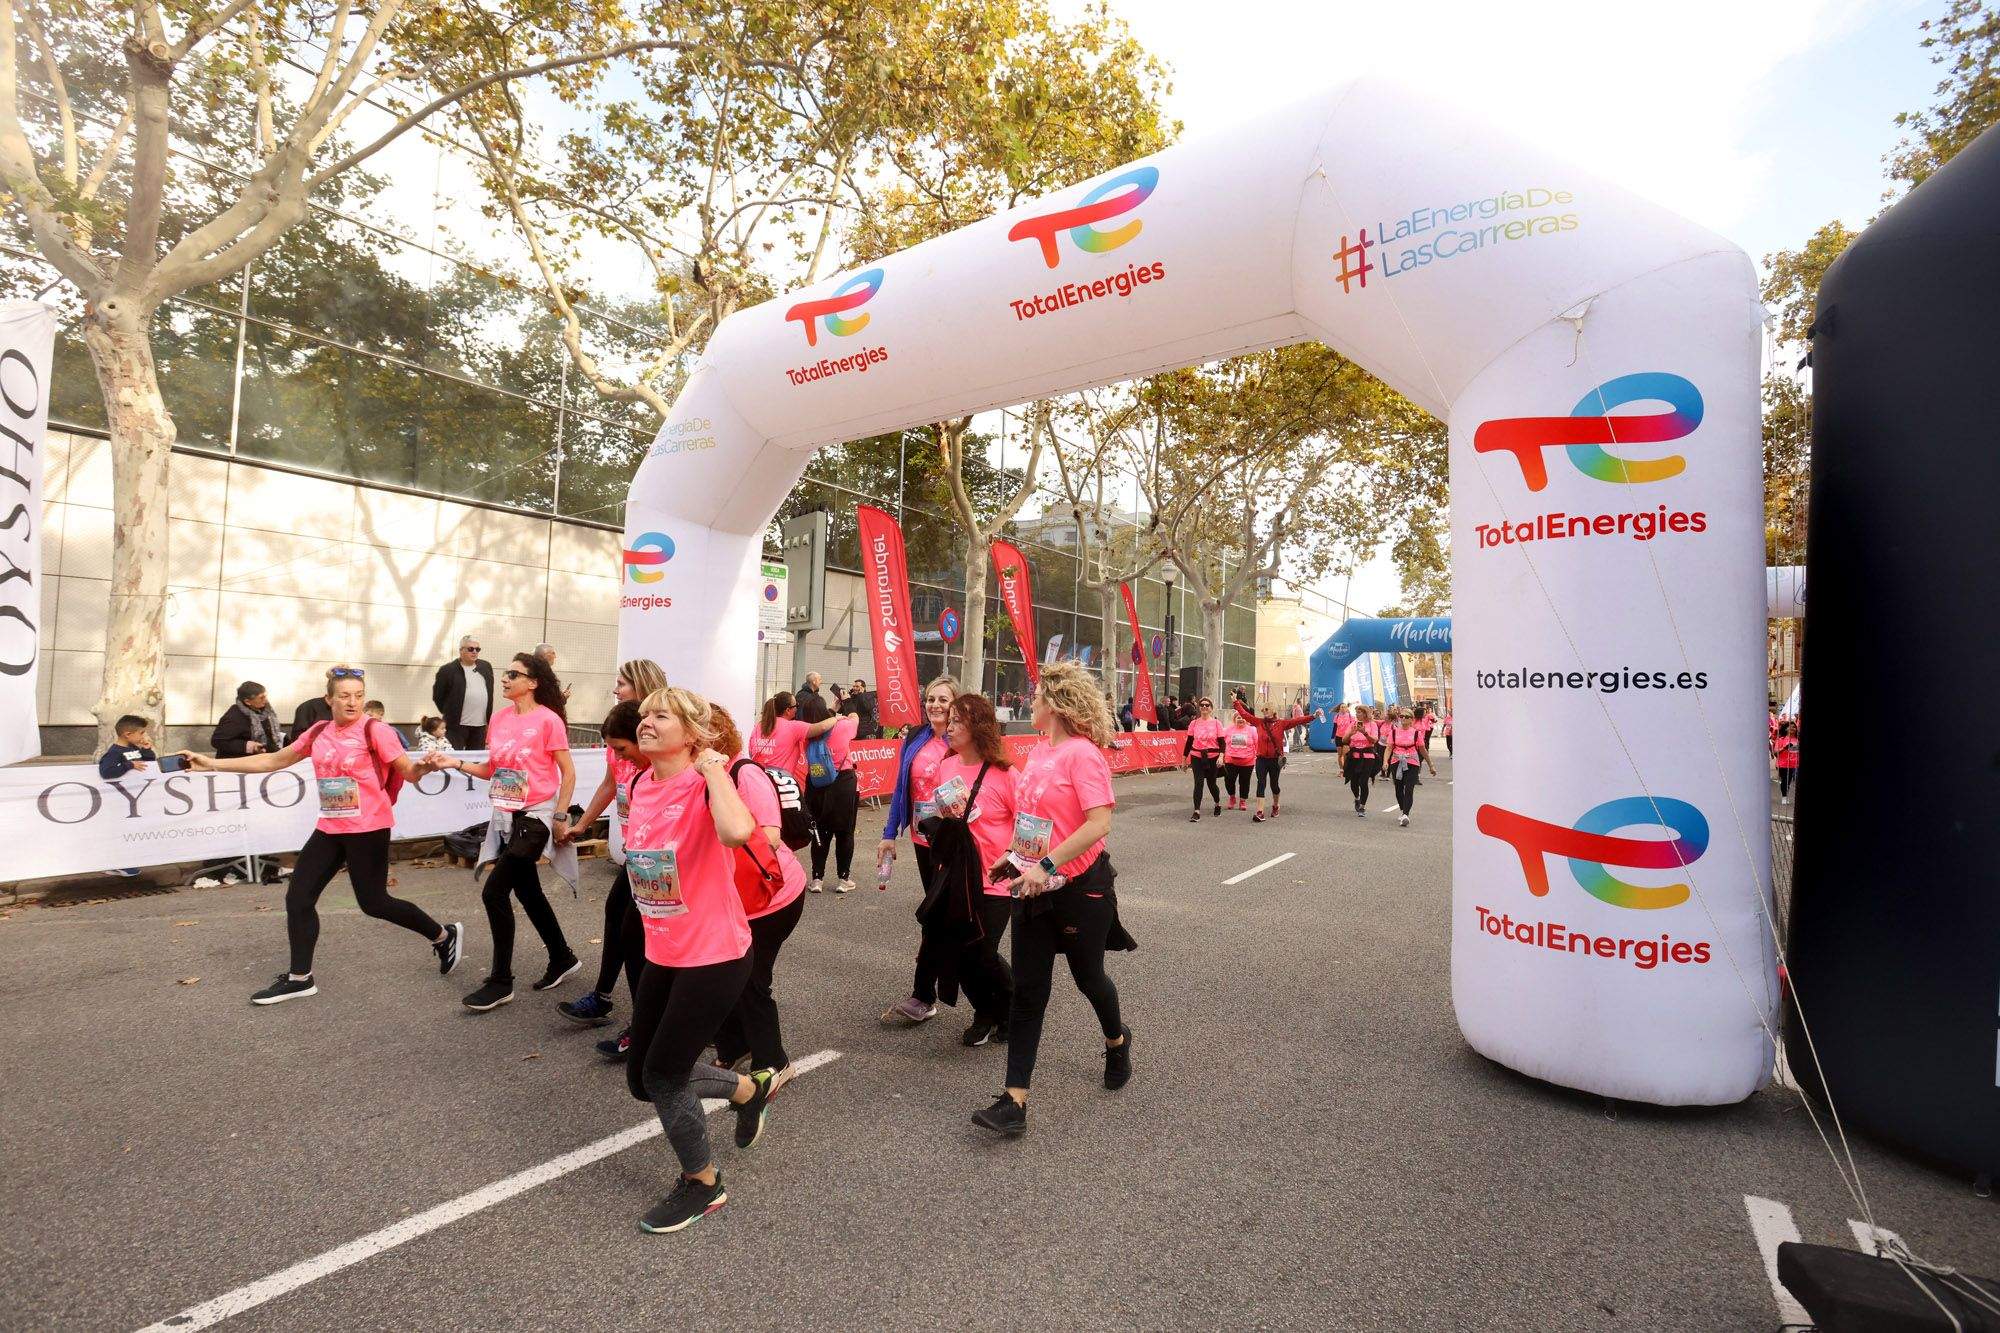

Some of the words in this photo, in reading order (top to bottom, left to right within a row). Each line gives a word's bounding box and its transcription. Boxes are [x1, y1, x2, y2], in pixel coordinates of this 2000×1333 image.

[1381, 213, 1579, 277] LasCarreras
[1009, 262, 1165, 321] TotalEnergies
[786, 346, 888, 386] TotalEnergies
[1475, 504, 1708, 548] TotalEnergies
[1390, 620, 1453, 648] Marlen
[1477, 666, 1708, 693] totalenergies.es
[851, 746, 896, 763] antander
[37, 770, 306, 824] OYSHO
[123, 823, 248, 843] WWW.OYSHO.COM
[1475, 905, 1711, 970] TotalEnergies
